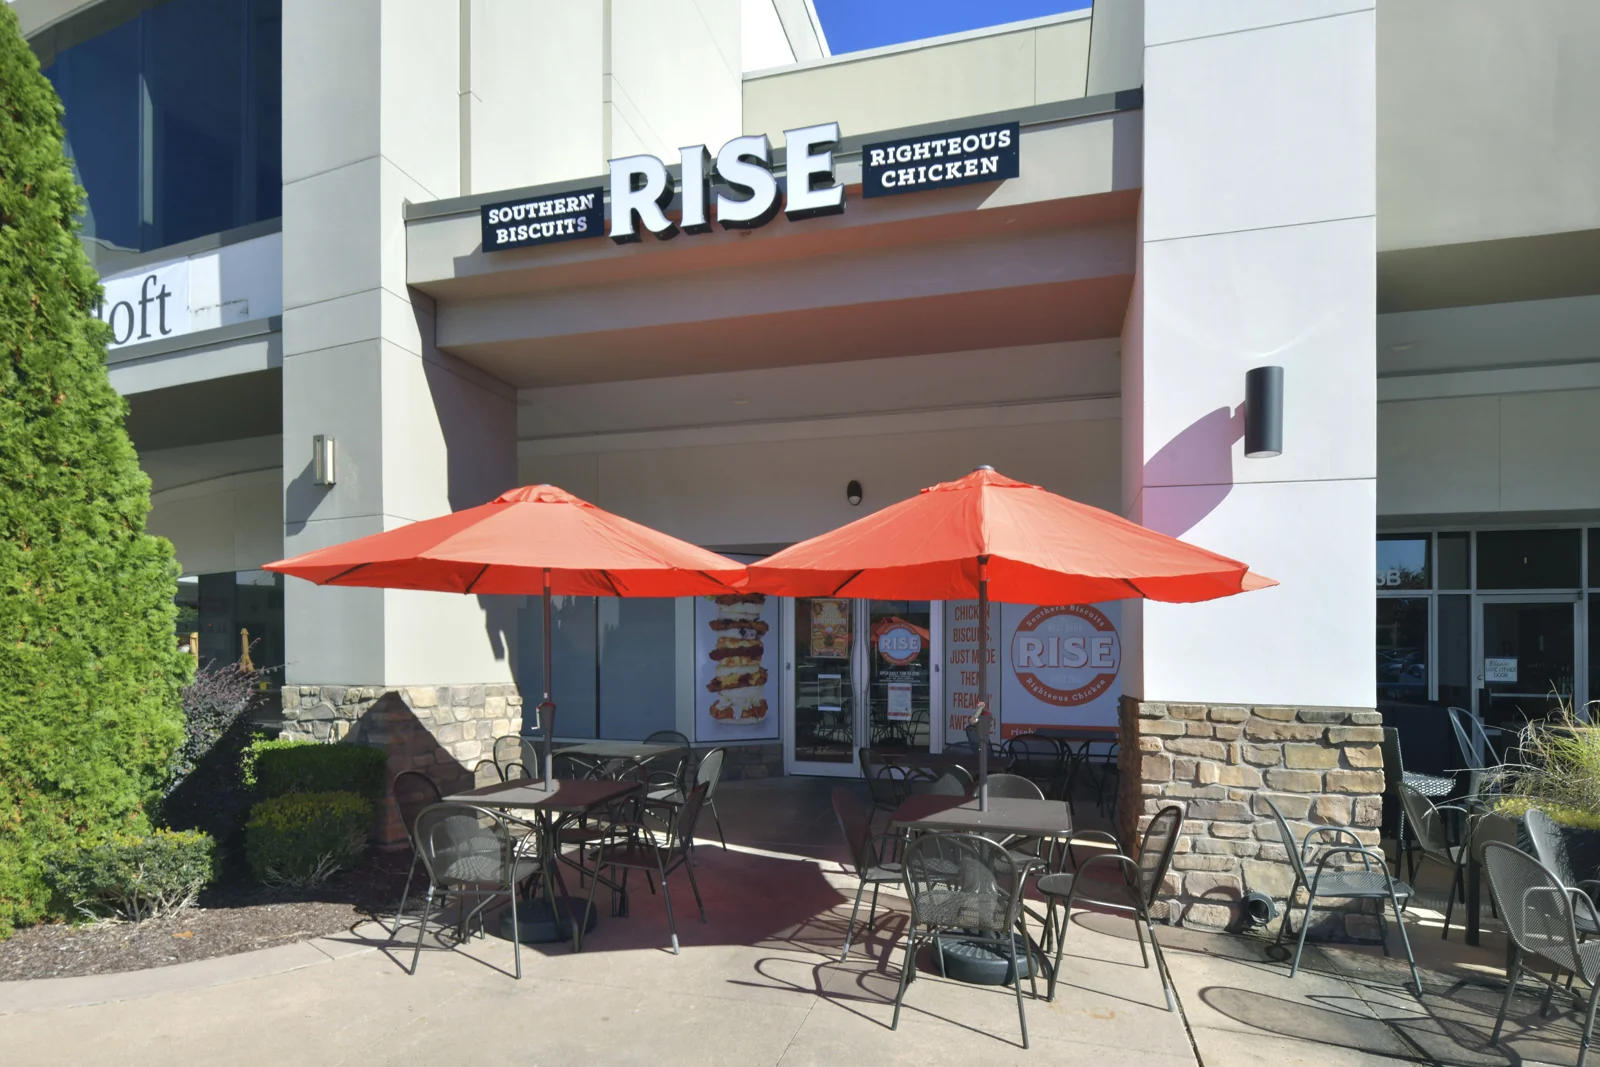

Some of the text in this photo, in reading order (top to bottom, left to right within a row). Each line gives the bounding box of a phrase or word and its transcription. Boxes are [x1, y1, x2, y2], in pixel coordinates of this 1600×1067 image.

[870, 129, 1011, 167] RIGHTEOUS
[607, 121, 845, 244] RISE
[881, 156, 999, 188] CHICKEN
[488, 193, 595, 225] SOUTHERN
[496, 216, 588, 244] BISCUITS
[954, 603, 991, 621] CHICKN
[1026, 604, 1066, 627] Southern
[1069, 604, 1105, 627] Biscuits
[881, 637, 919, 650] RISE
[1017, 636, 1115, 669] RISE
[949, 648, 996, 664] JUST MDE
[960, 671, 981, 686] THE
[1025, 677, 1068, 701] Righteous
[1071, 679, 1106, 701] Chicken
[952, 692, 993, 710] FREAKN'
